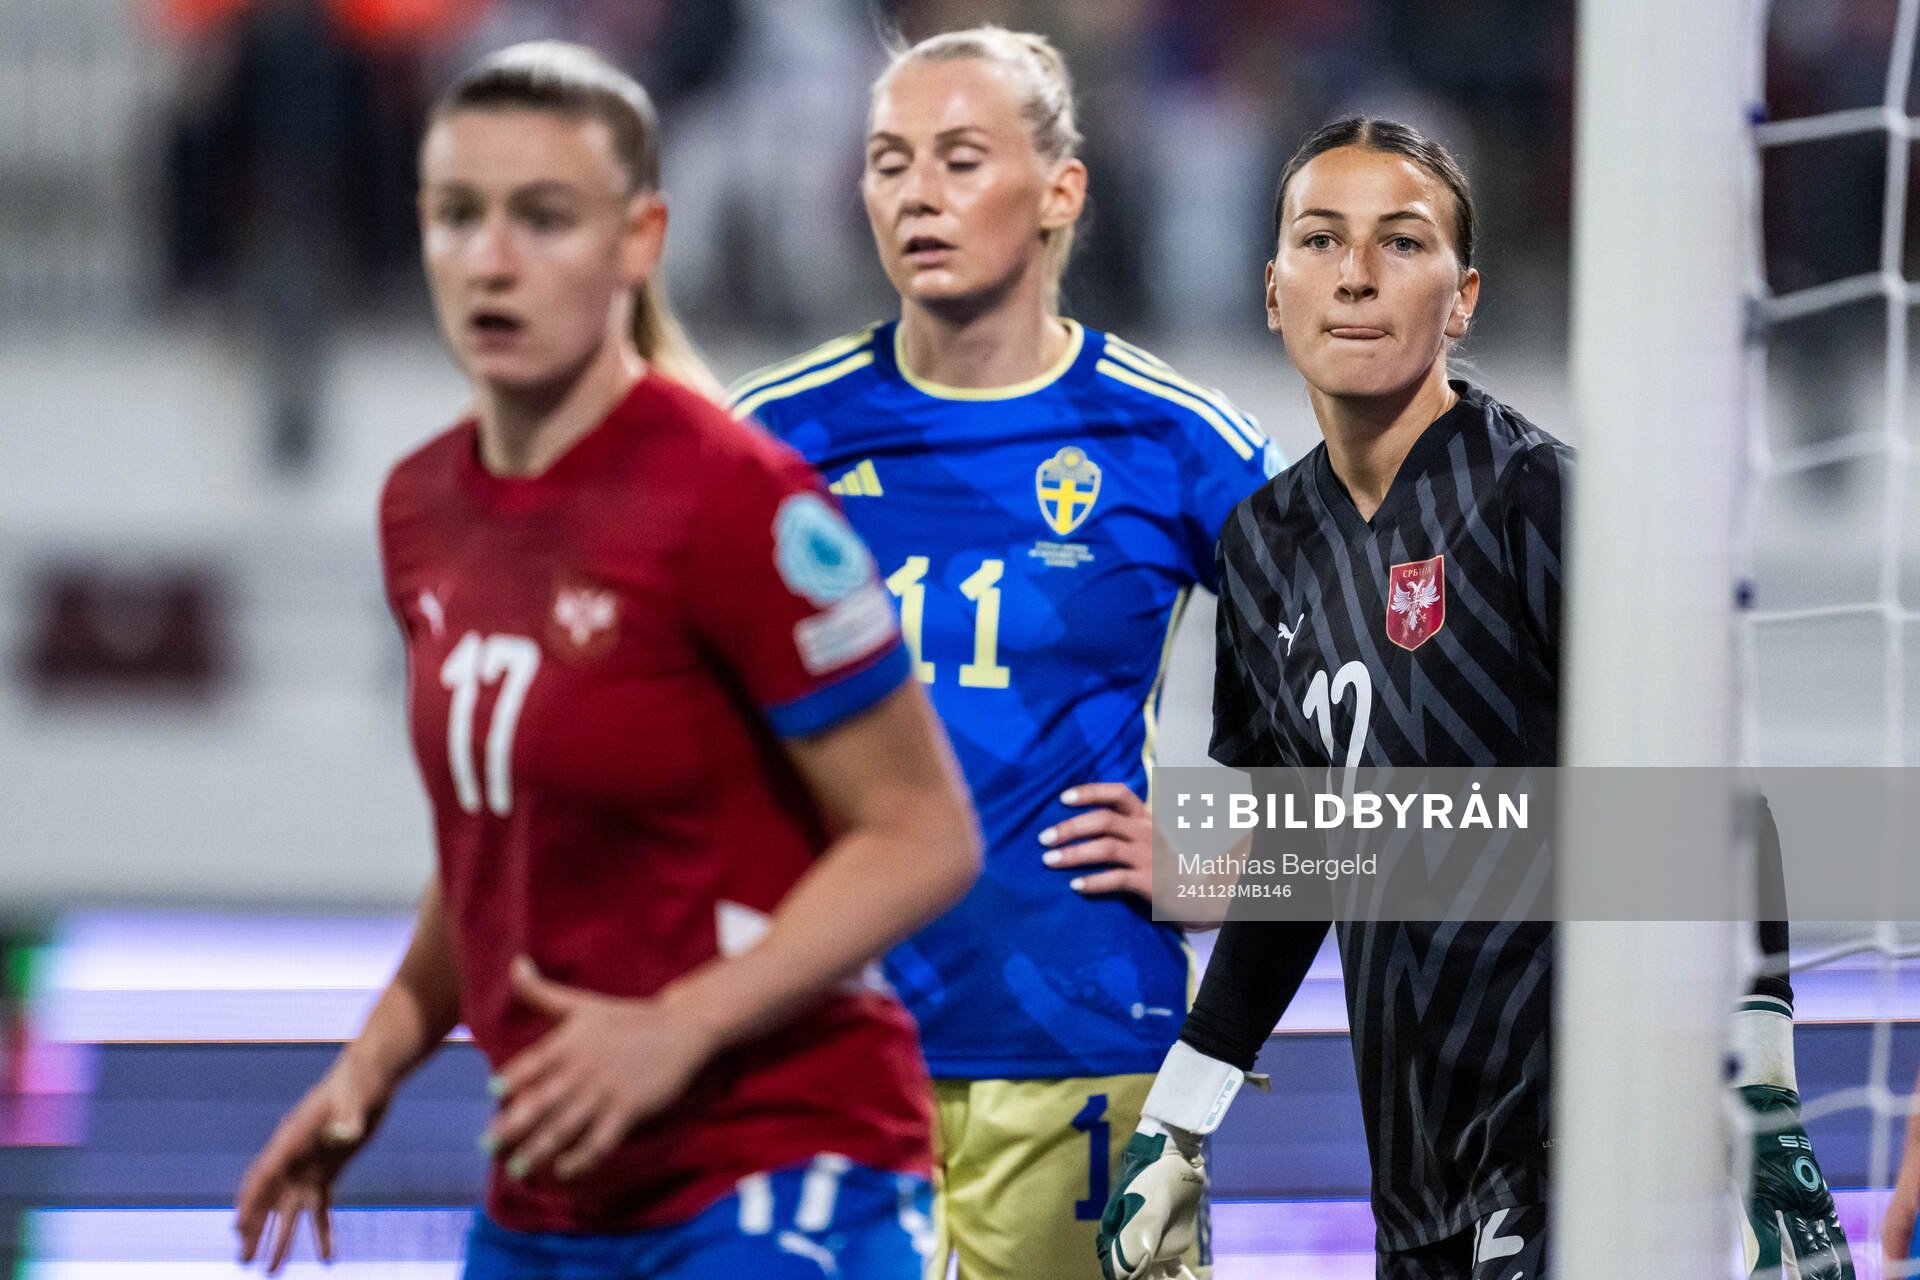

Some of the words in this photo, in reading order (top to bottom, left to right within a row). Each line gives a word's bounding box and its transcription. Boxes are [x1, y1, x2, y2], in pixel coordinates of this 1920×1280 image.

[886, 556, 1010, 689] 11
[440, 630, 541, 817] 17
[1302, 660, 1373, 821] 12
